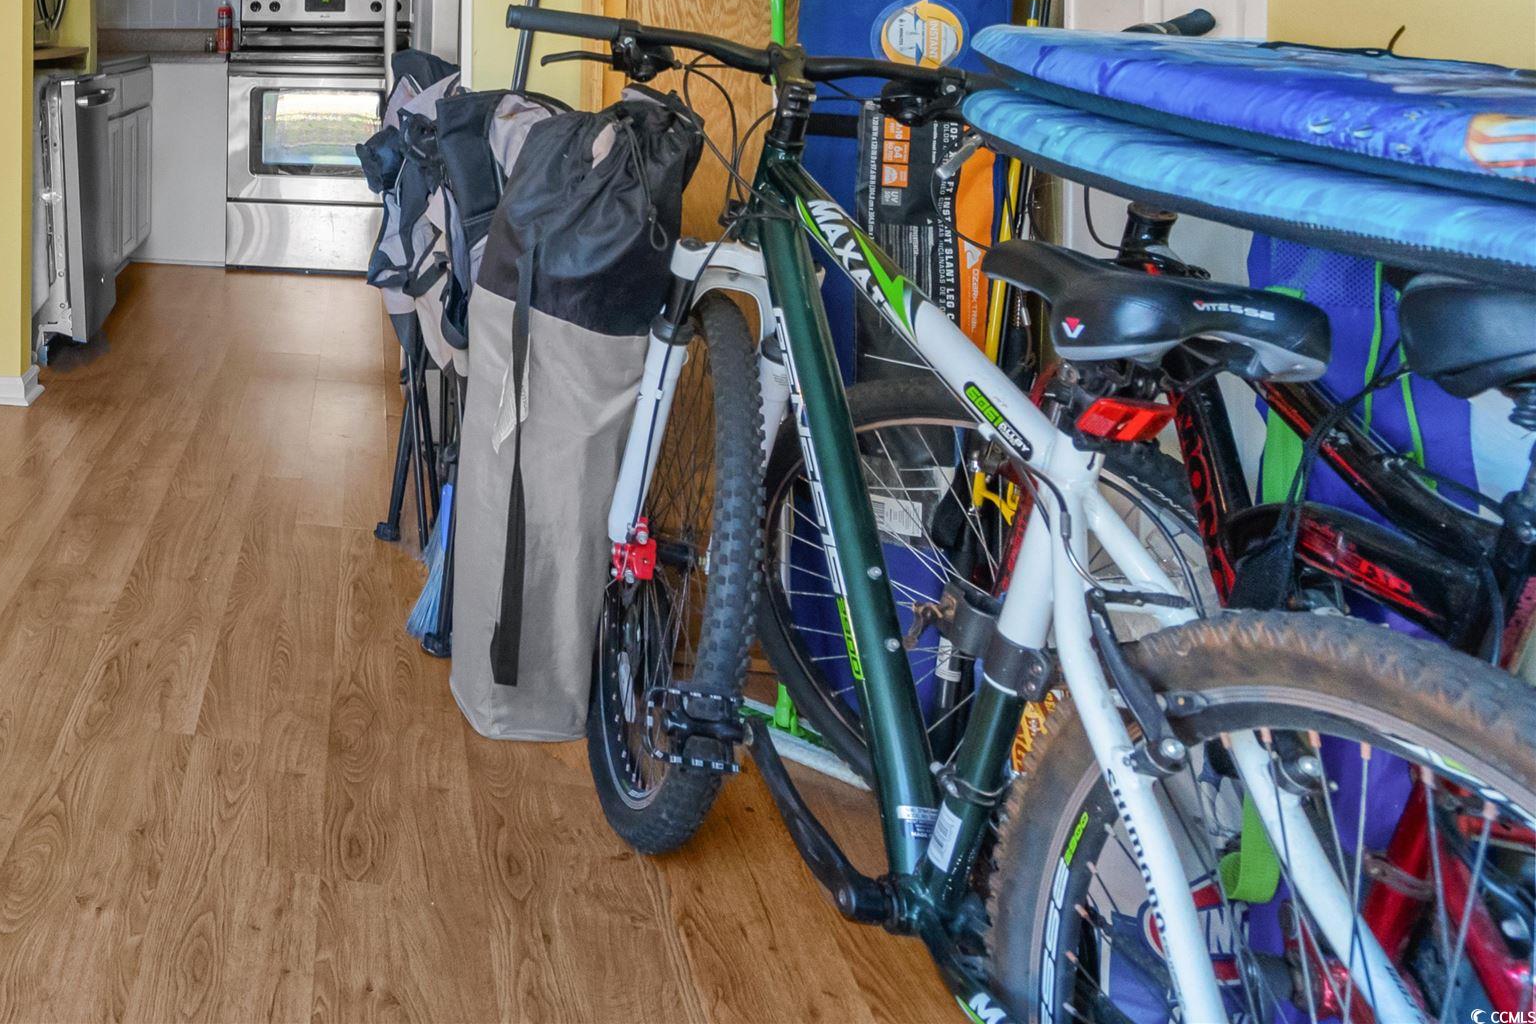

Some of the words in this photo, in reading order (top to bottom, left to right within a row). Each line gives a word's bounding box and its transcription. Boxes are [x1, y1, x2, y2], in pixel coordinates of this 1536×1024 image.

[929, 21, 939, 58] INSTANT
[891, 190, 899, 204] UV
[944, 248, 955, 284] SLANT
[946, 288, 955, 309] LEG
[1193, 299, 1275, 321] VITESSE
[772, 307, 848, 597] GENESIS
